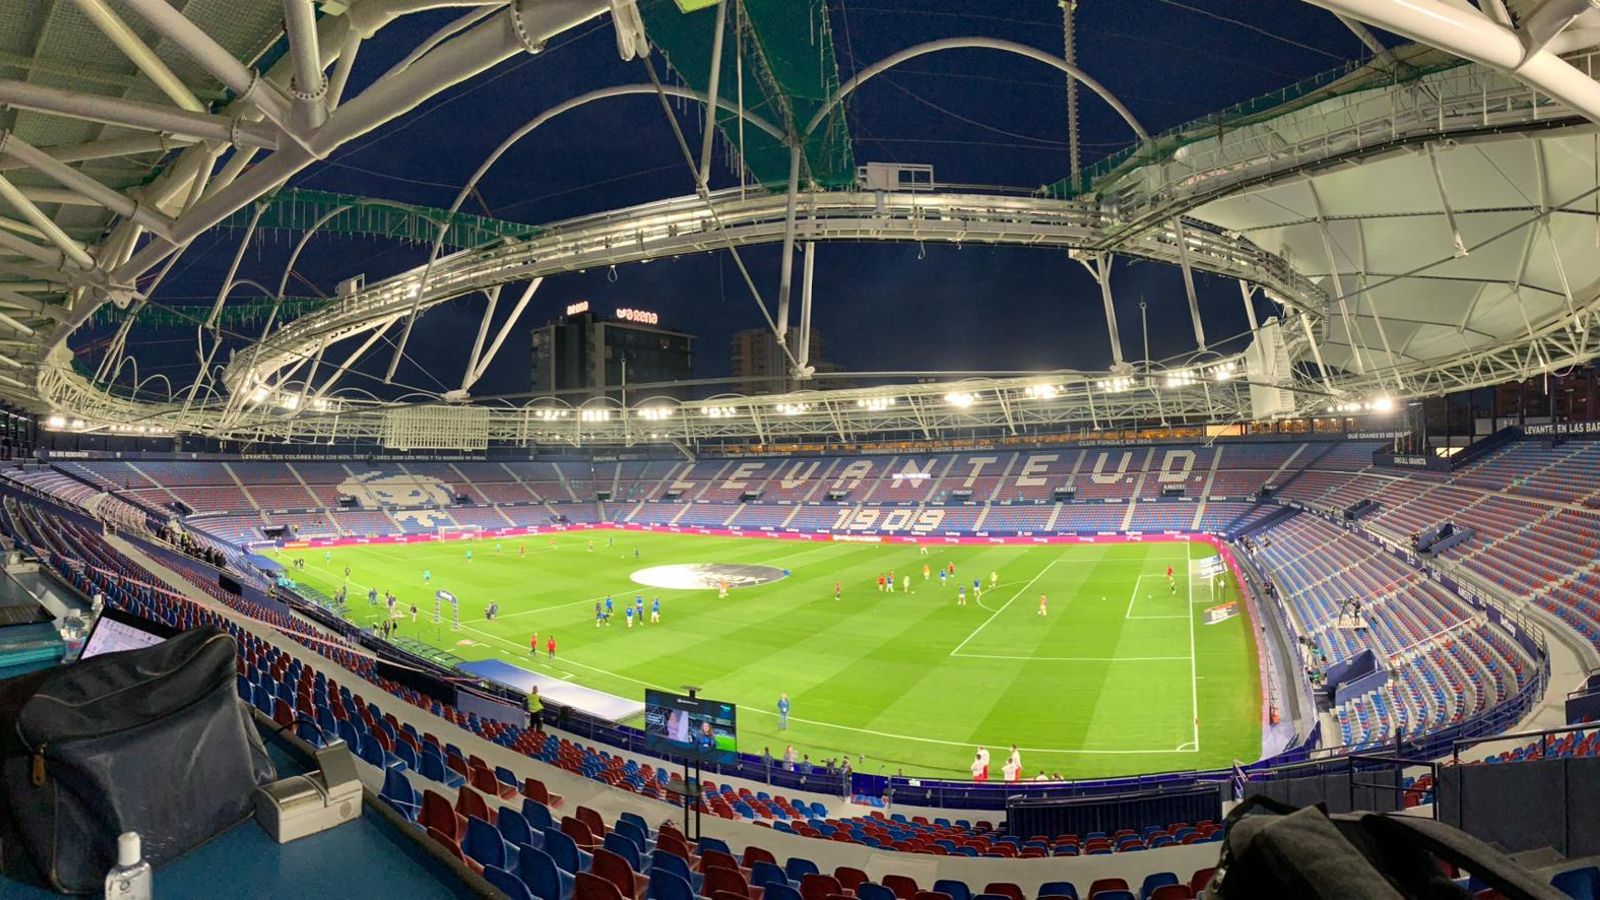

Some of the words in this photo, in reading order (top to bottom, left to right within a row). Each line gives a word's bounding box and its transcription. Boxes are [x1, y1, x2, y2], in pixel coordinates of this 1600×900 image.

[1557, 424, 1567, 433] EN
[1569, 423, 1584, 433] LAS
[832, 509, 945, 532] 1909
